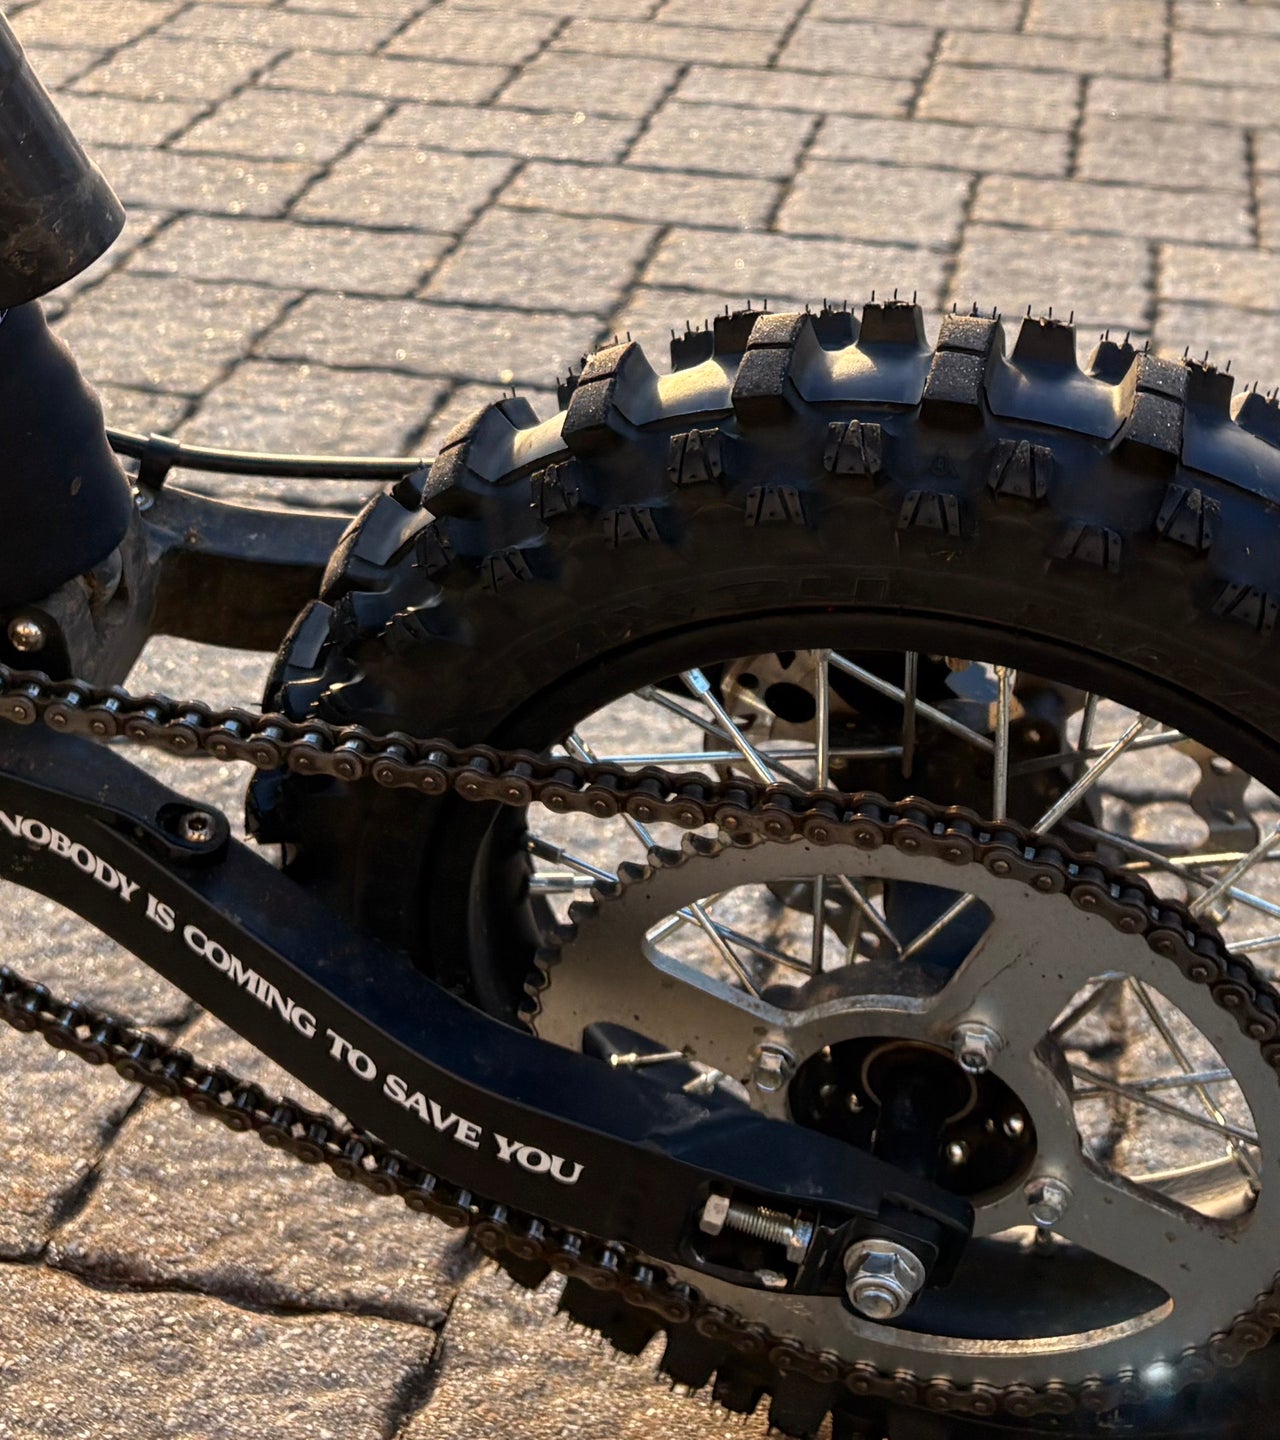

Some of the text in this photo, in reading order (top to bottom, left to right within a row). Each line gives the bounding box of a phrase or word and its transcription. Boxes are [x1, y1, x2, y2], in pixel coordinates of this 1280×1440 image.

[145, 893, 176, 932] IS
[183, 924, 317, 1040] COMING
[325, 1027, 378, 1081] TO
[382, 1074, 483, 1149] SAVE
[493, 1132, 585, 1186] YOU
